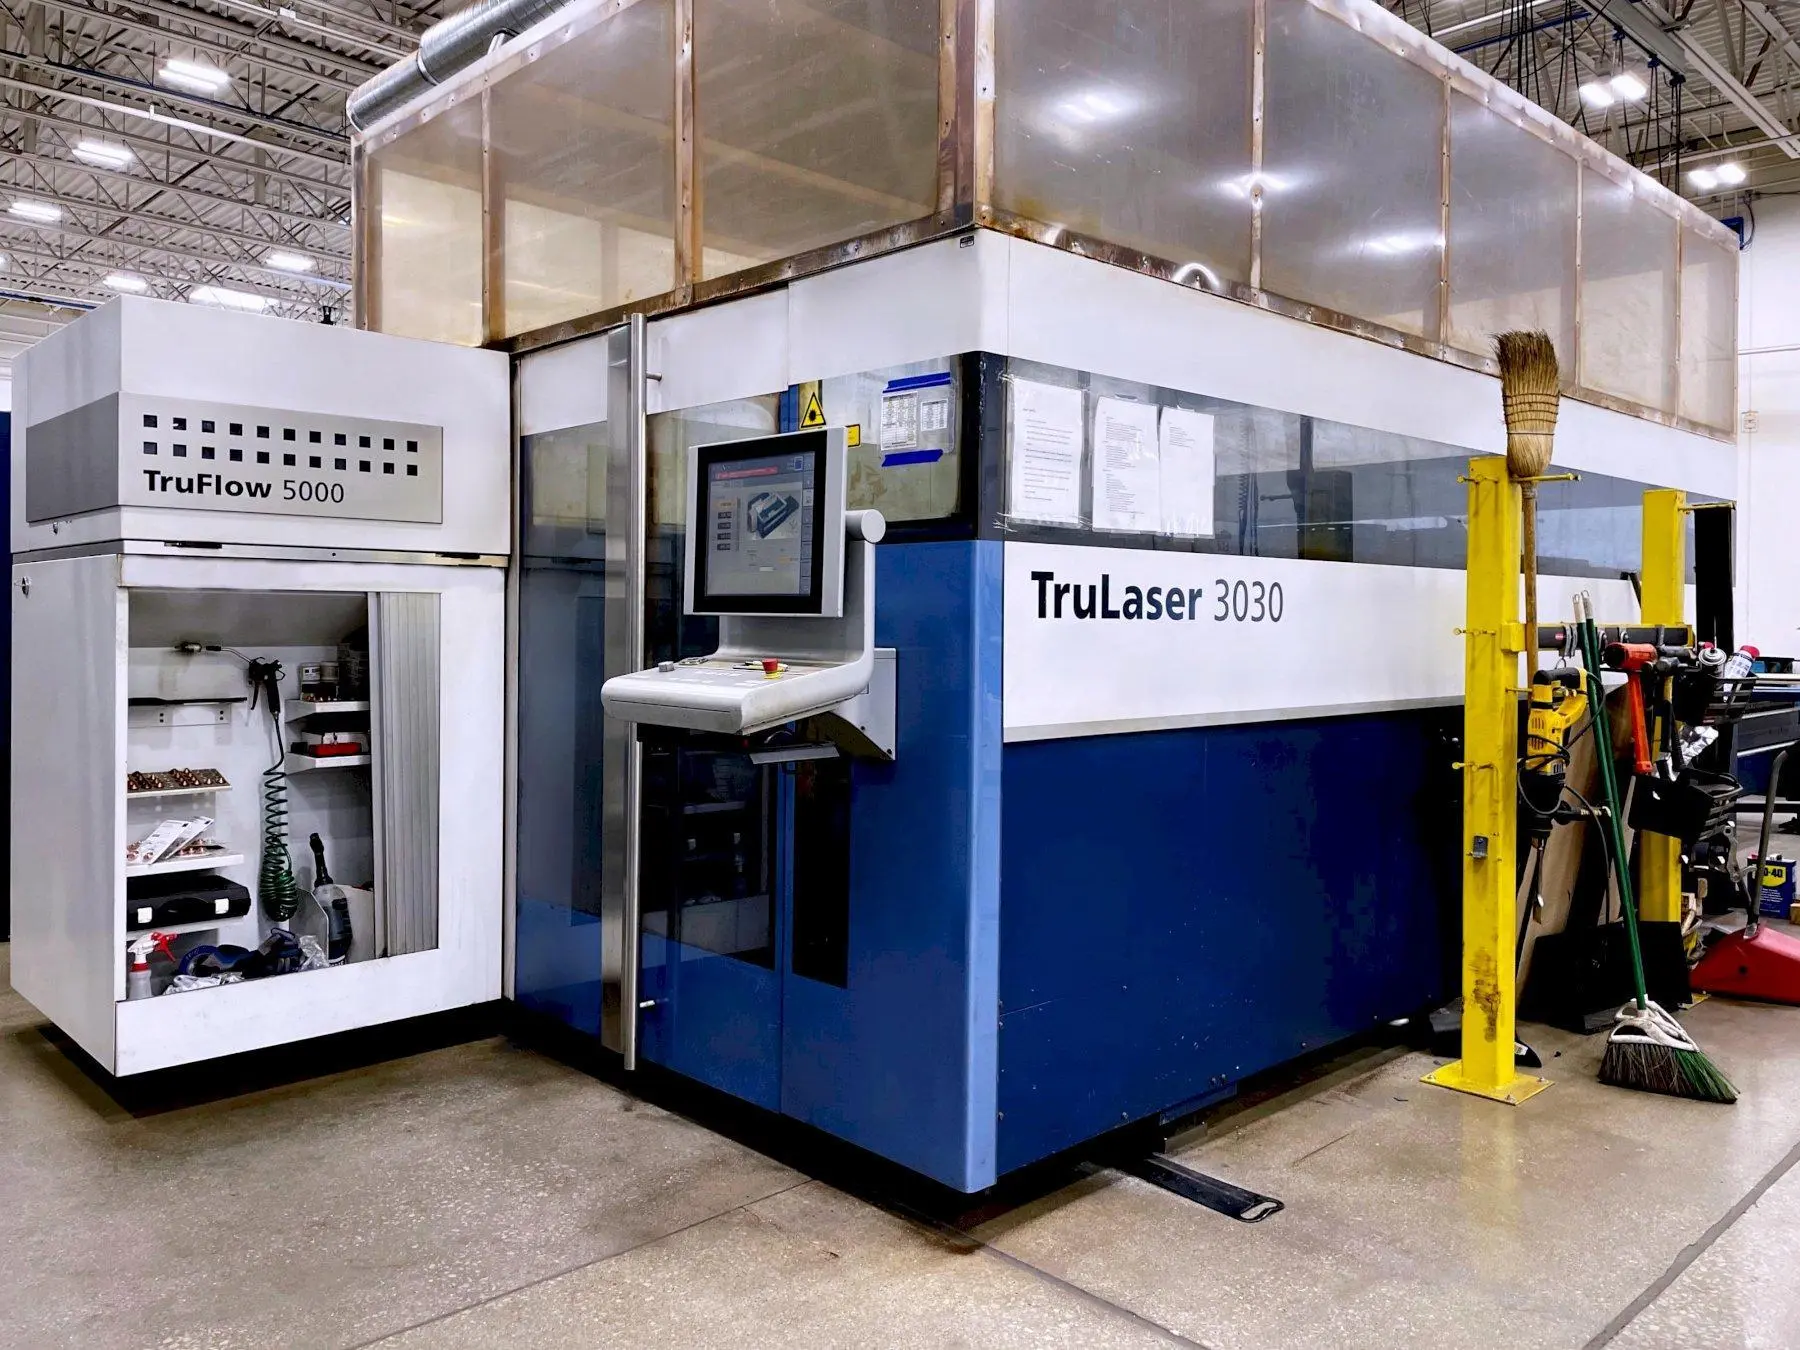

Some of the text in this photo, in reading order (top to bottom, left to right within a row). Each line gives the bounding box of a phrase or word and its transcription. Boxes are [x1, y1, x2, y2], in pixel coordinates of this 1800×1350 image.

[143, 469, 345, 503] TruFlow 5000
[1031, 570, 1284, 623] TruLaser 3030
[1761, 867, 1783, 878] D-40
